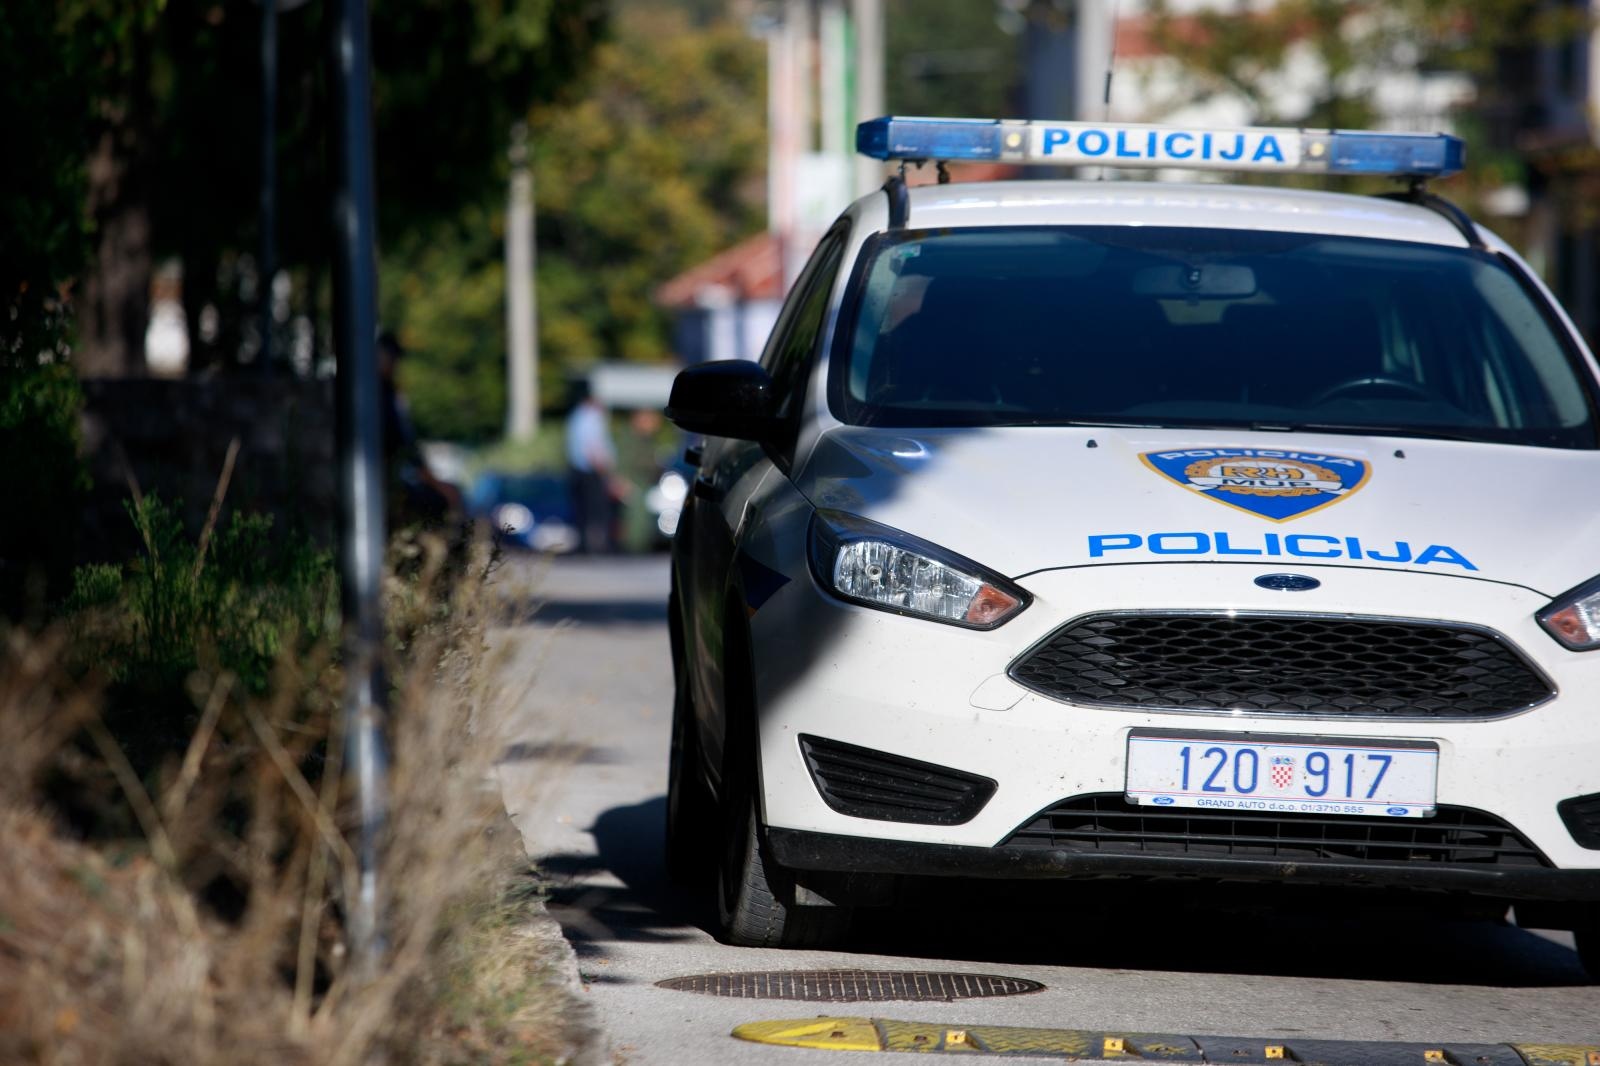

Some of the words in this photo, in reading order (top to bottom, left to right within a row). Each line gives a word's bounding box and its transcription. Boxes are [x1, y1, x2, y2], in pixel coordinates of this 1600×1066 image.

[1042, 128, 1285, 162] POLICIJA
[1158, 450, 1356, 467] POLICIJA
[1221, 466, 1304, 479] RH
[1222, 479, 1311, 487] MUP
[1088, 532, 1479, 571] POLICIJA
[1180, 746, 1258, 794] 120
[1304, 751, 1392, 799] 917
[1197, 799, 1235, 808] GRAND
[1238, 801, 1266, 809] AUTO
[1344, 806, 1365, 814] 555
